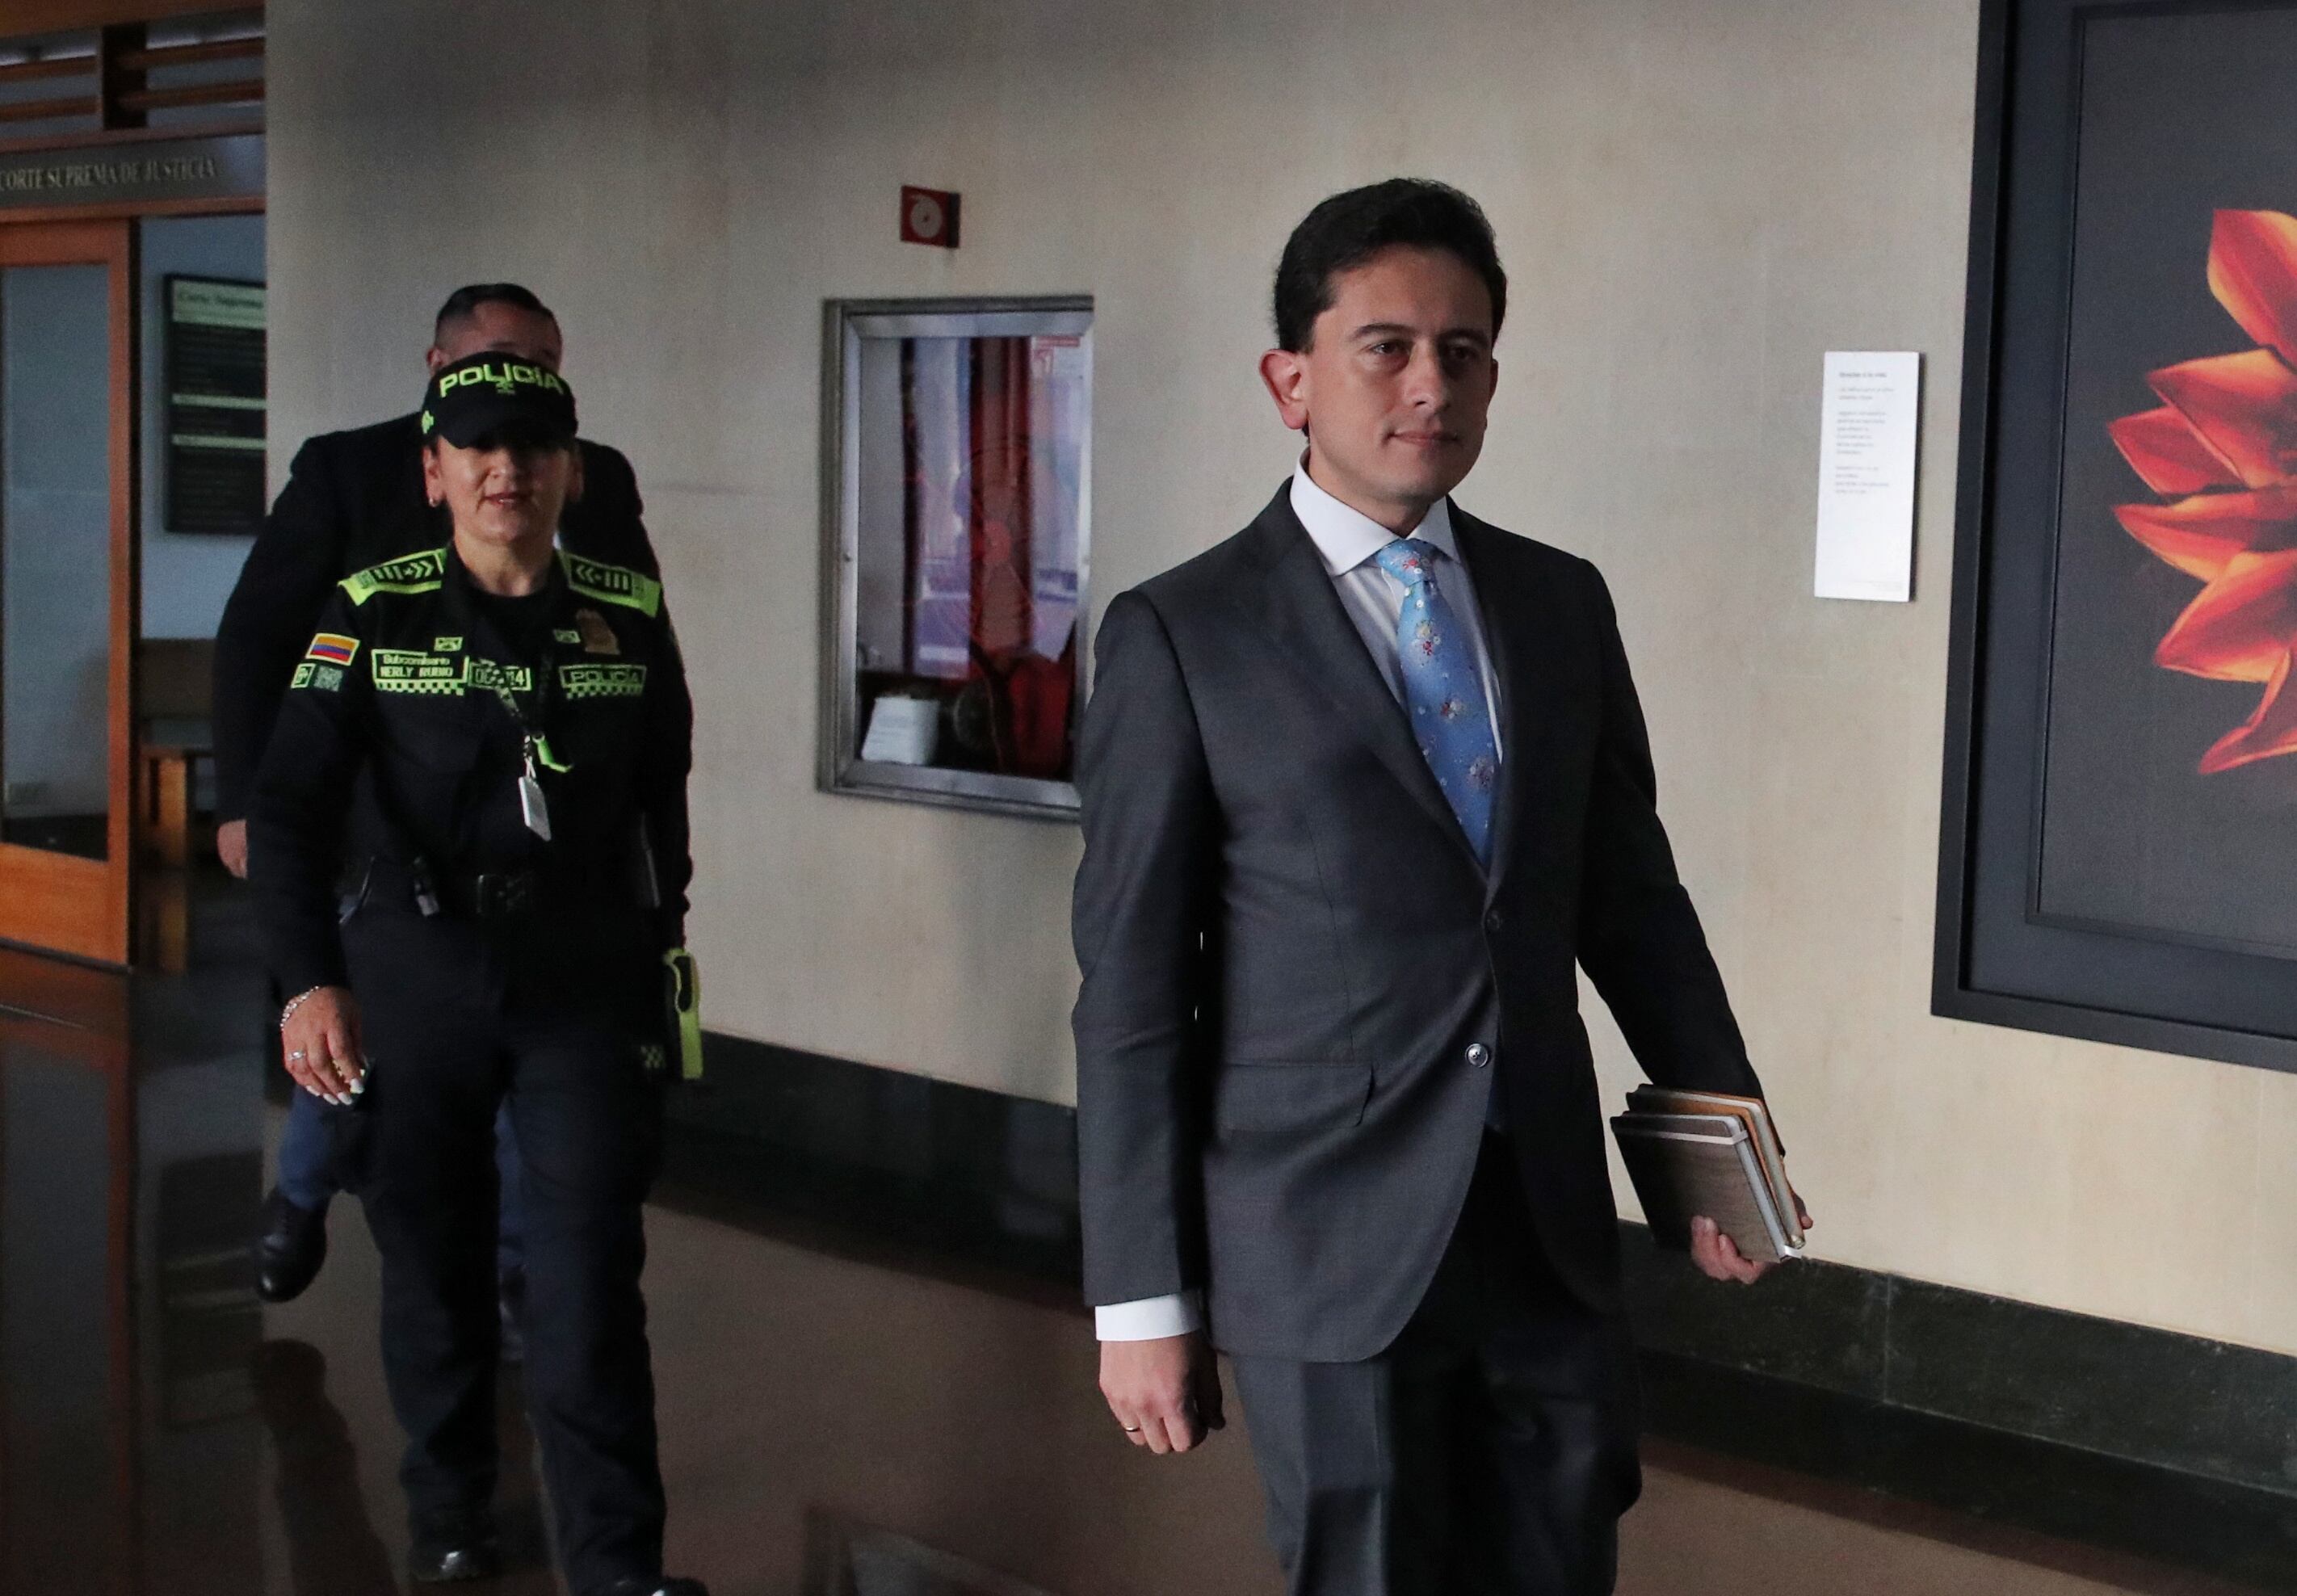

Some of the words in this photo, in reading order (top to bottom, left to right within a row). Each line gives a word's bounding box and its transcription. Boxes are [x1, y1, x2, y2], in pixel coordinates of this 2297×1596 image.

[47, 163, 118, 188] SUPREMA
[120, 161, 141, 184] DE
[143, 158, 218, 182] JUSTICIA
